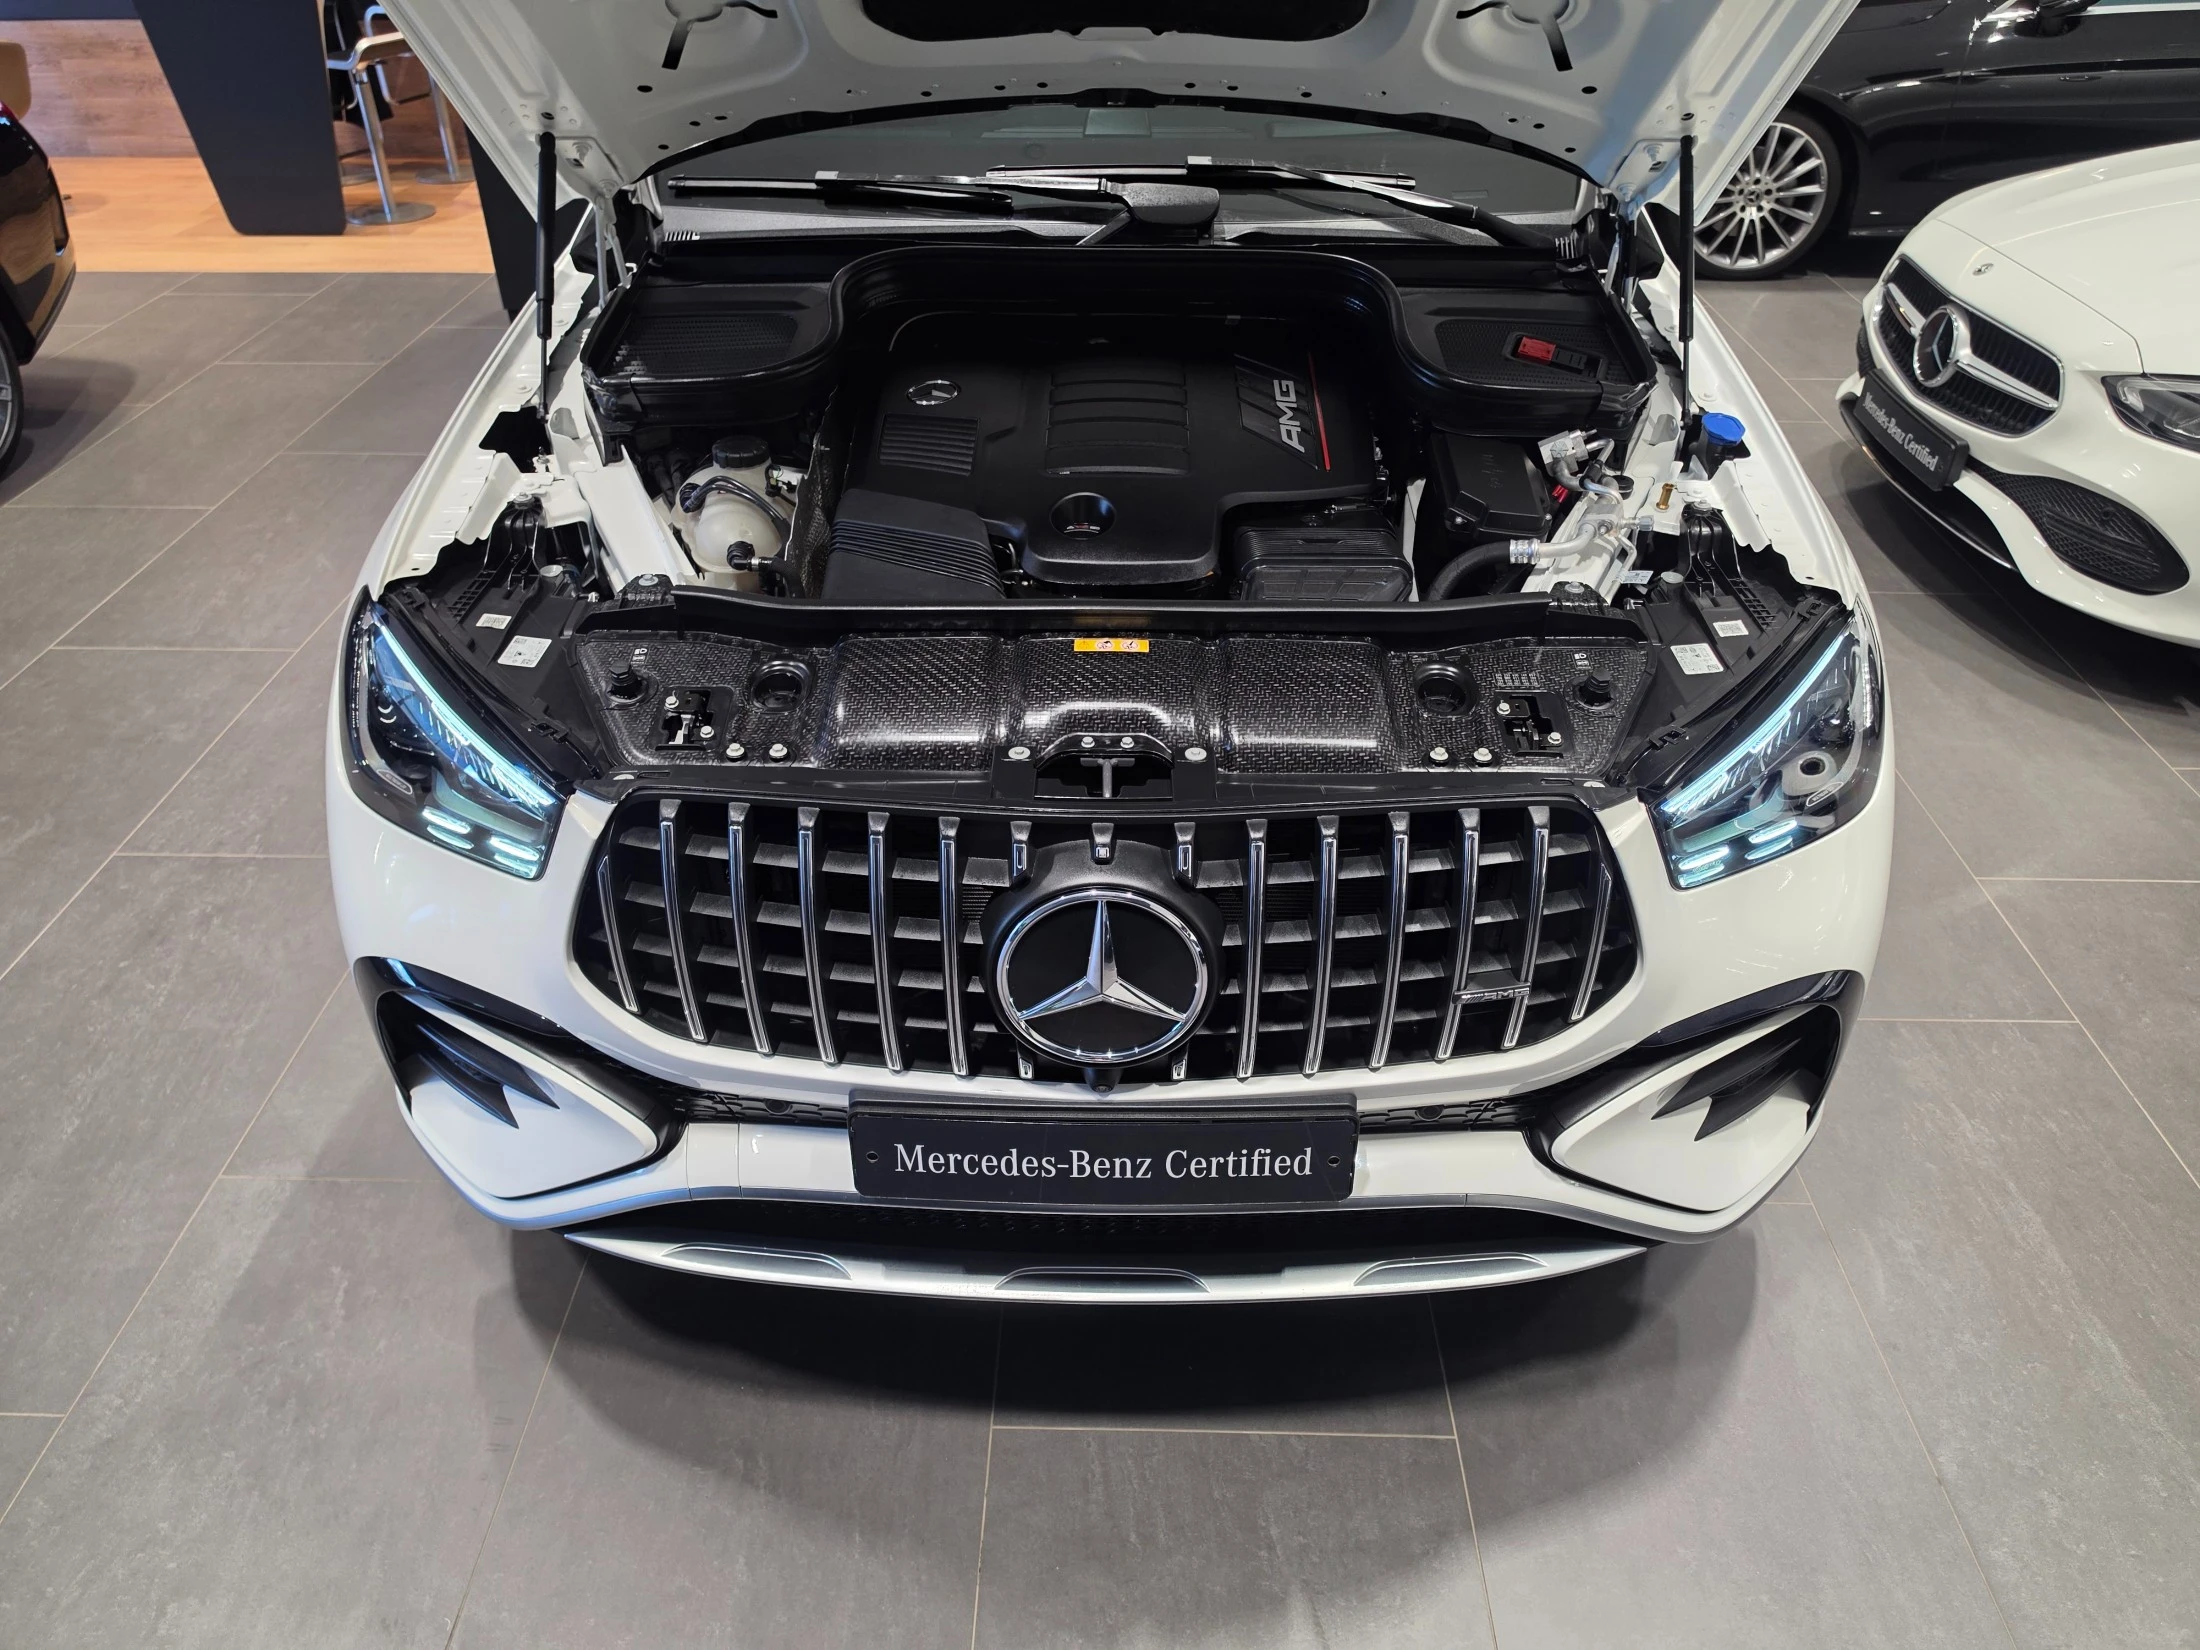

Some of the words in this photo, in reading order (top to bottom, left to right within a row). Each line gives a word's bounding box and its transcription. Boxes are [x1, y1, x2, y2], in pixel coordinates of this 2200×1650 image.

[1273, 379, 1305, 453] AMG
[1862, 391, 1905, 444] Mercedes-Benz
[1903, 433, 1939, 472] Certified
[1483, 987, 1530, 1001] AMG
[893, 1143, 1152, 1178] Mercedes-Benz
[1165, 1146, 1312, 1178] Certified
